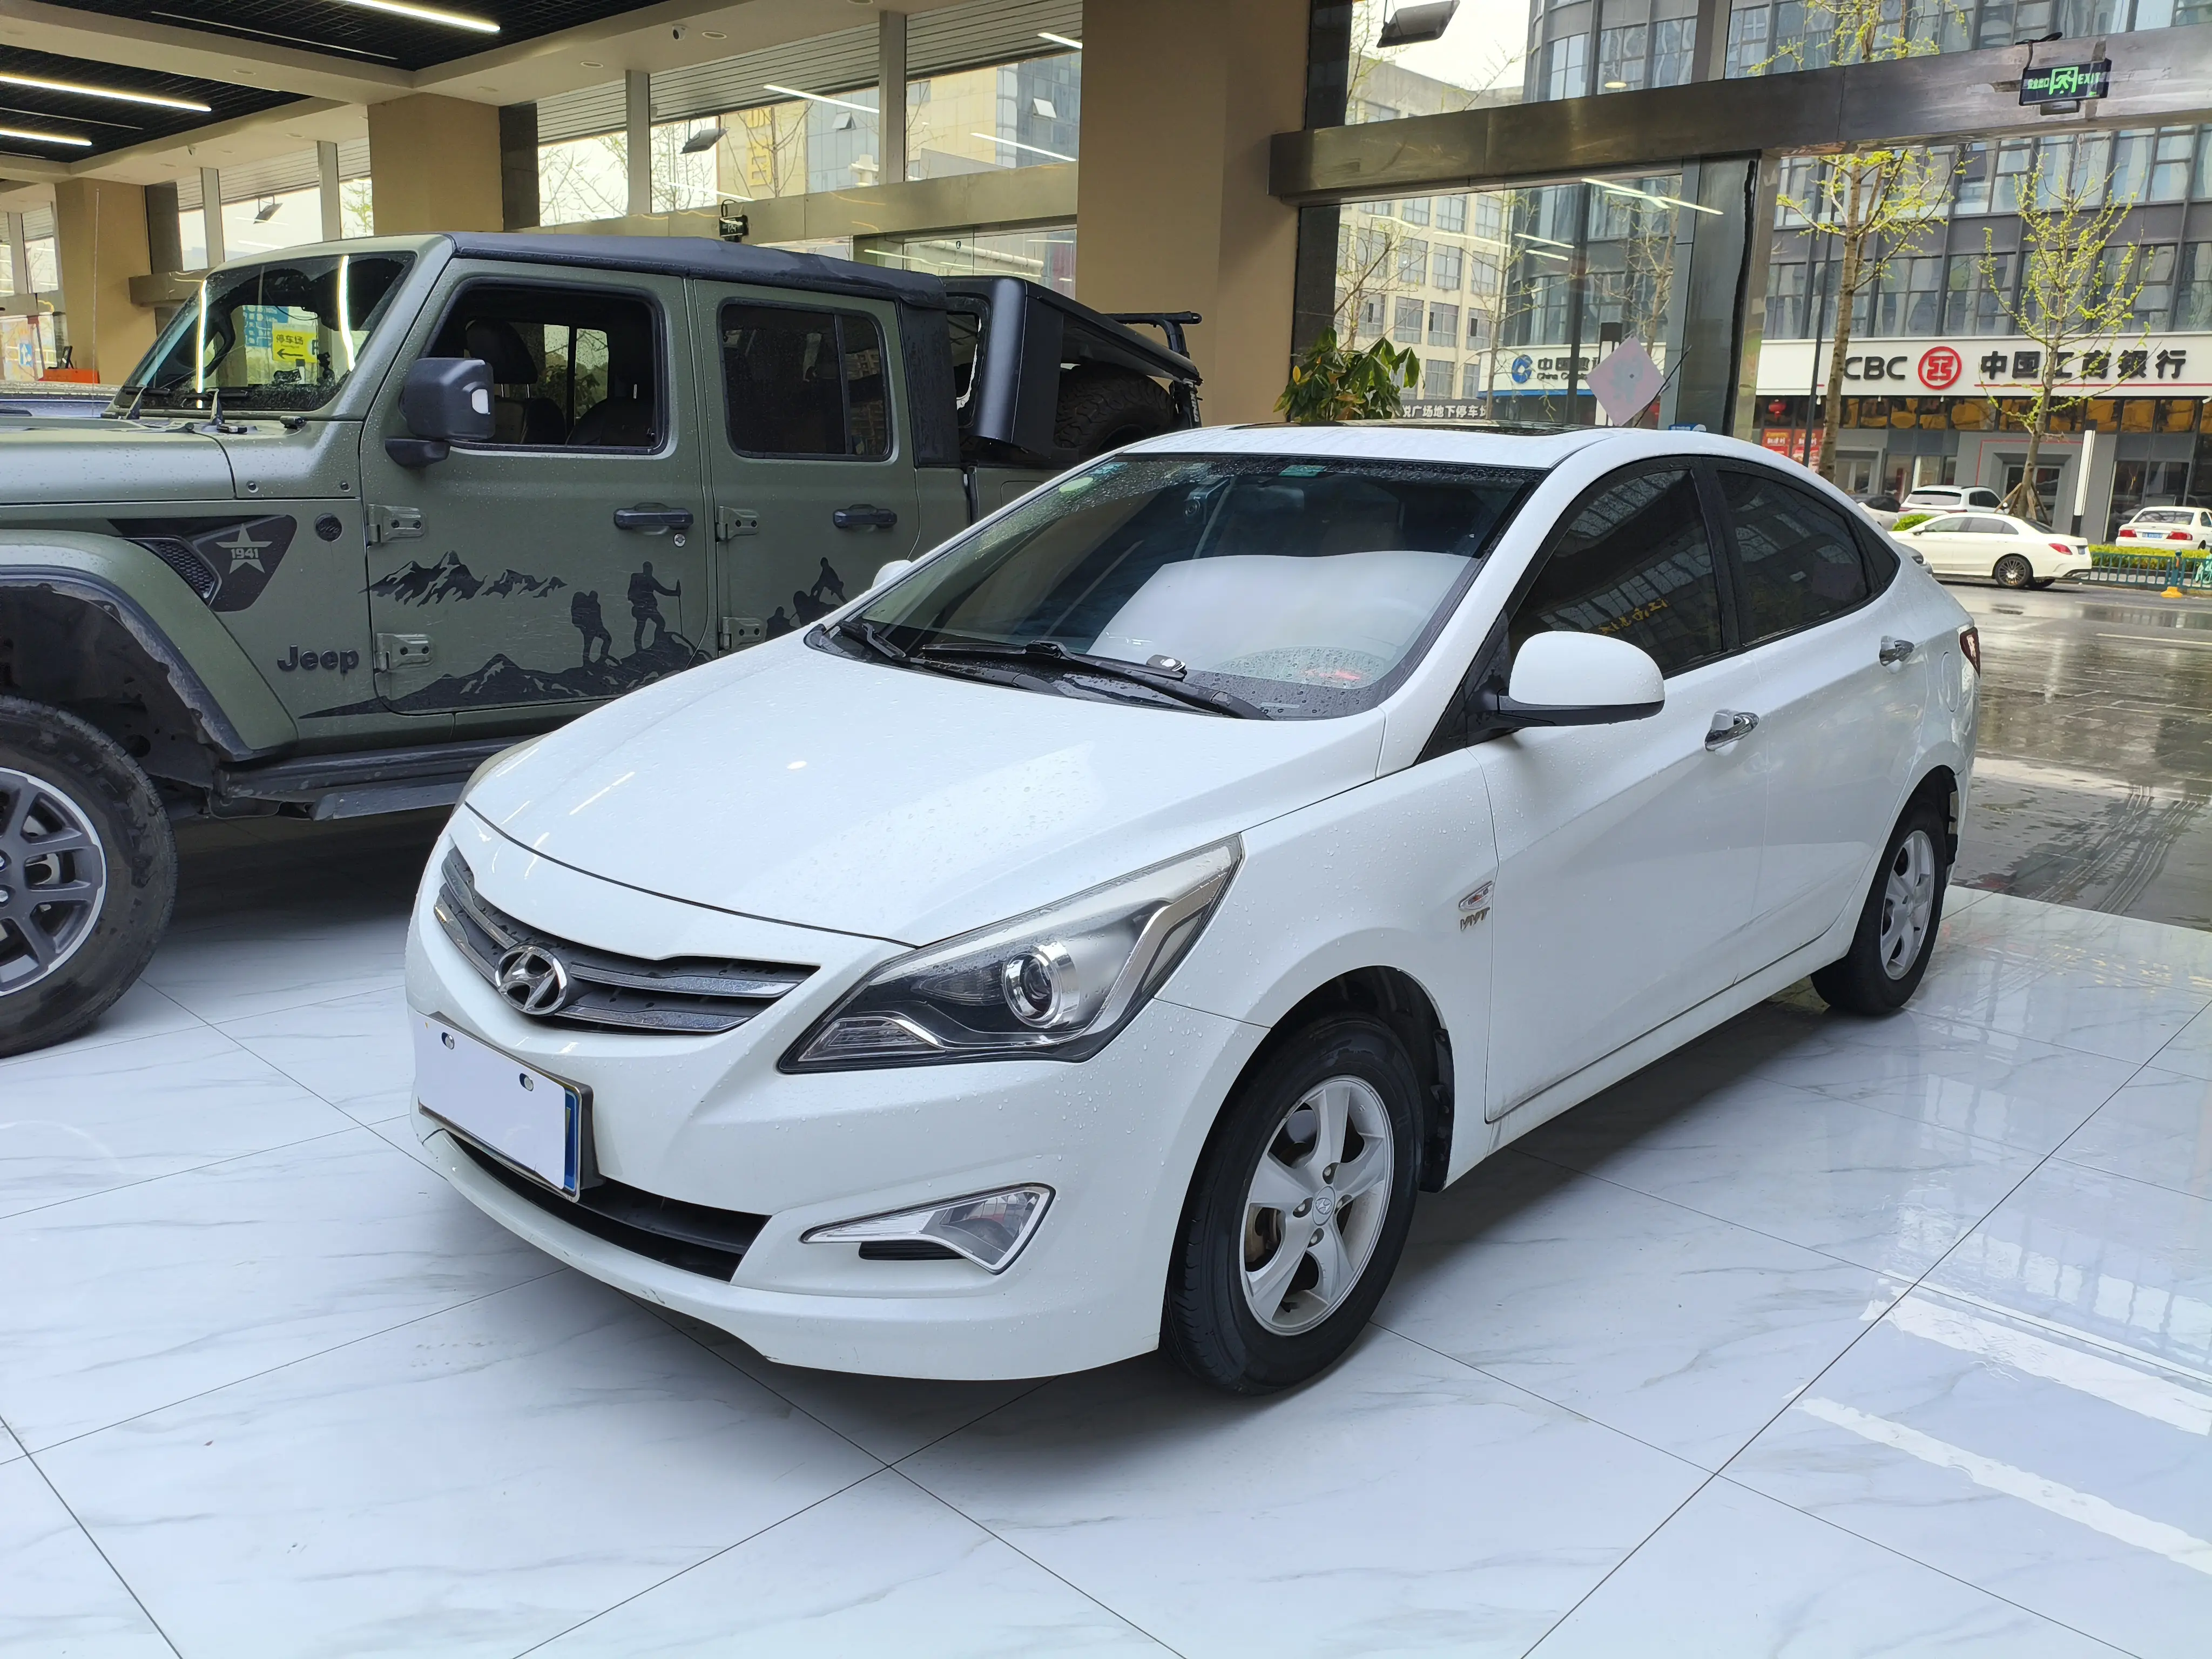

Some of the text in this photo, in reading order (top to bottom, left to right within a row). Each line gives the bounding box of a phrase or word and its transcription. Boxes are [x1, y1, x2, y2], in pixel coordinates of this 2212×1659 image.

[2078, 72, 2101, 85] EXIT
[276, 334, 304, 345] 停车场
[1844, 355, 1907, 380] CBC
[1980, 349, 2187, 380] 中国工商银行
[231, 548, 259, 558] 1941
[277, 644, 360, 675] Jeep
